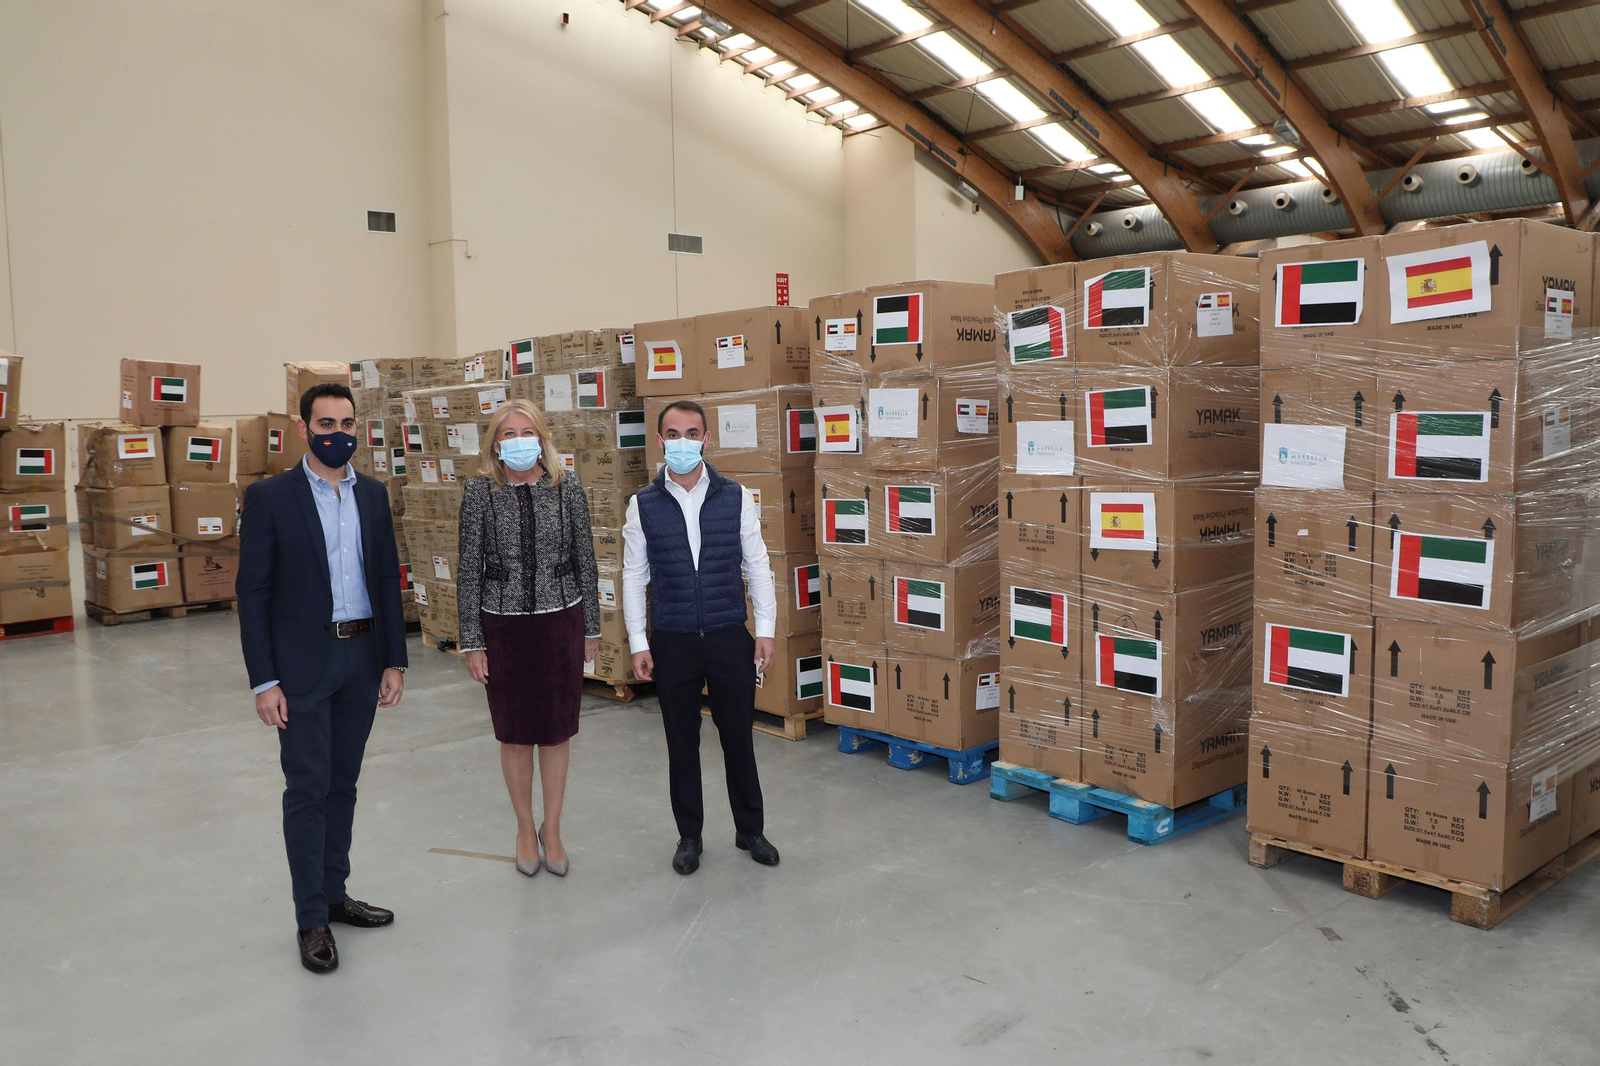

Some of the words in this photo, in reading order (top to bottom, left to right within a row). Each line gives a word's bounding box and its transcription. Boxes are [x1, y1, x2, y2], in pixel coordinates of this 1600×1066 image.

[956, 327, 996, 342] YAMAK
[1196, 408, 1241, 426] YAMAK
[1188, 430, 1212, 439] Disposable
[1205, 510, 1226, 519] Protective
[1227, 508, 1249, 516] Disposable
[1193, 513, 1205, 522] Mask
[1122, 619, 1128, 628] 2
[1200, 622, 1242, 646] YAMAK
[1410, 682, 1424, 690] QTY:
[1457, 695, 1471, 703] KGS
[1457, 702, 1470, 710] KGS
[1200, 728, 1240, 754] YAMAK
[1192, 756, 1215, 770] Disposable
[1404, 812, 1419, 820] N.W:
[1451, 829, 1464, 837] KGS
[1416, 837, 1431, 845] MADE
